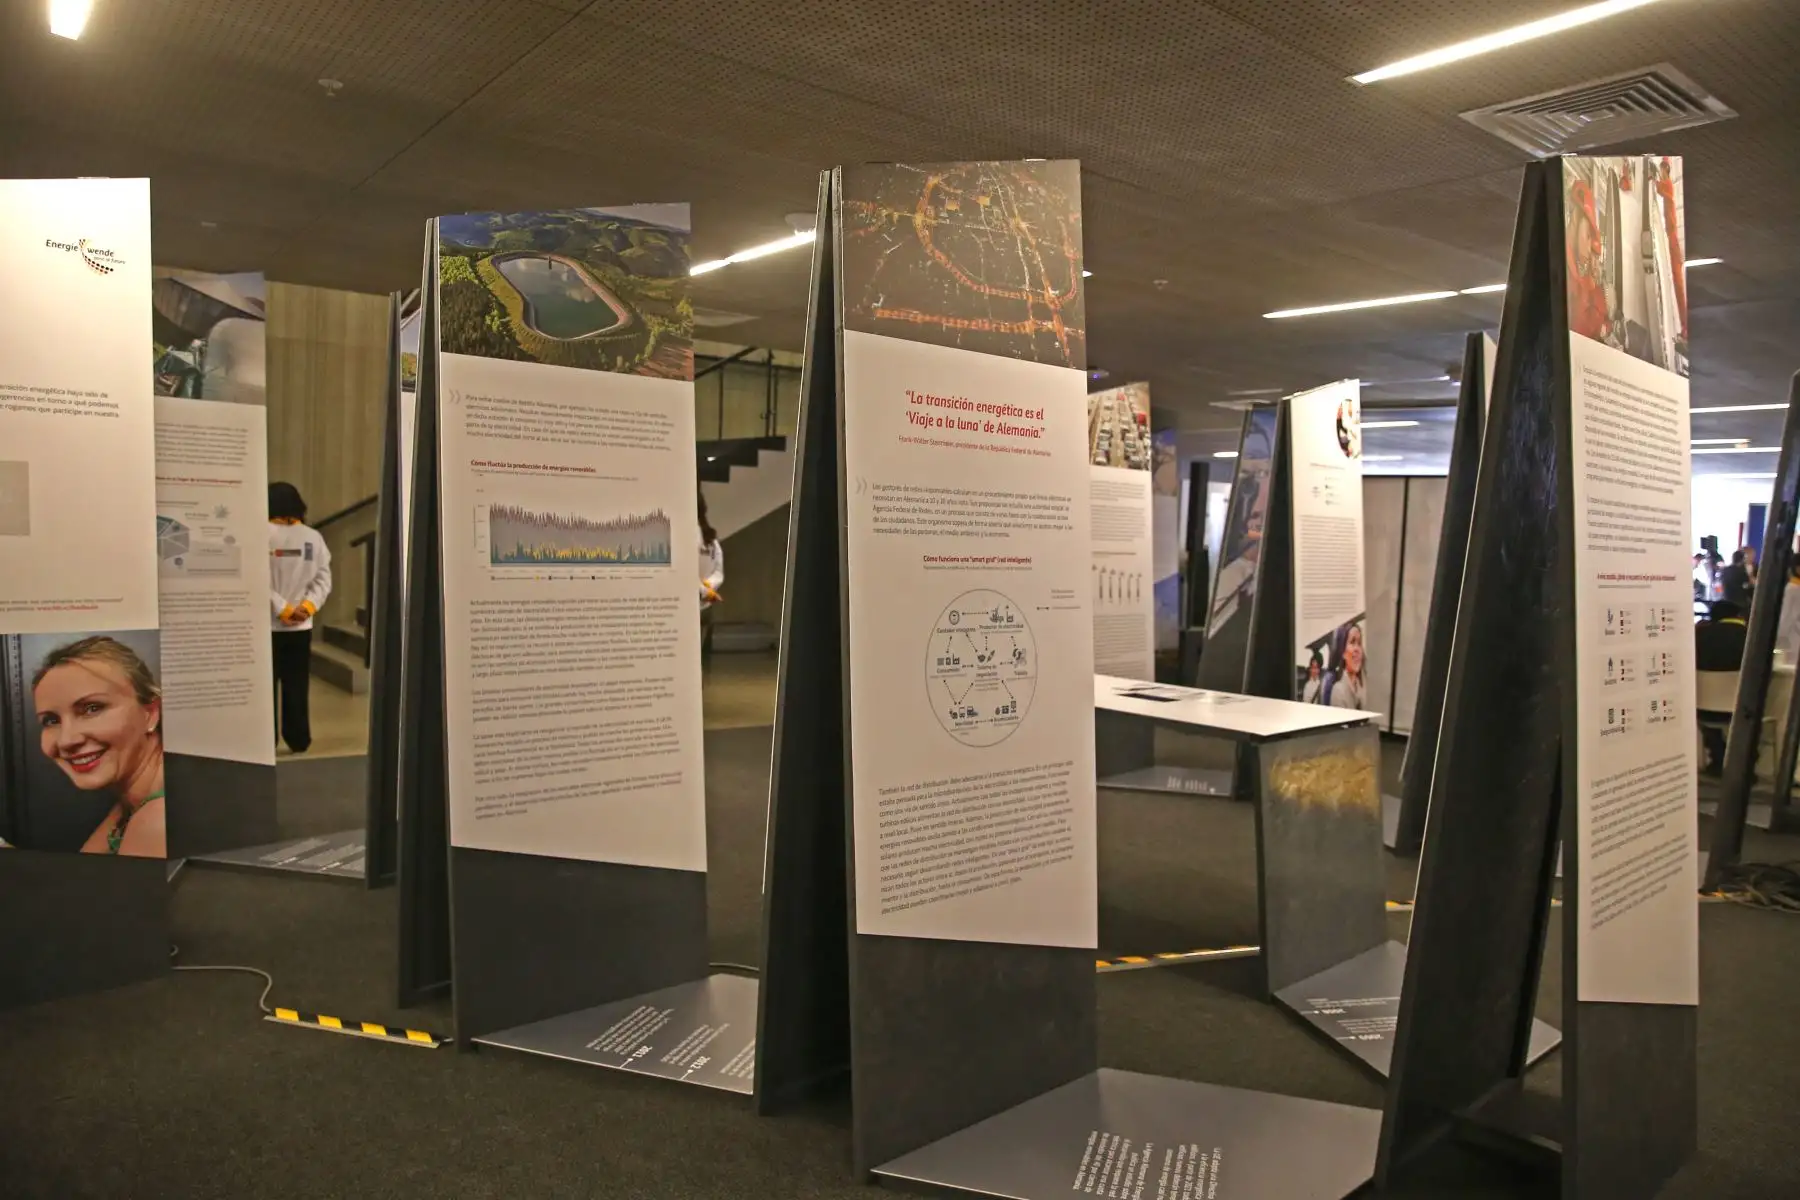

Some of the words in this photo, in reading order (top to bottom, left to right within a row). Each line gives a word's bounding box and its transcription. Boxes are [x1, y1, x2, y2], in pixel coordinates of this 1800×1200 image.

[46, 239, 79, 252] Energie
[87, 247, 115, 257] wende
[905, 390, 923, 404] “La
[926, 394, 974, 412] transición
[976, 402, 1023, 418] energética
[1025, 409, 1034, 419] es
[1035, 408, 1044, 420] el
[905, 411, 934, 429] ‘Viaje
[936, 418, 943, 428] a
[945, 415, 955, 428] la
[957, 417, 982, 431] luna’
[983, 420, 994, 433] de
[996, 421, 1046, 439] Alemania.”
